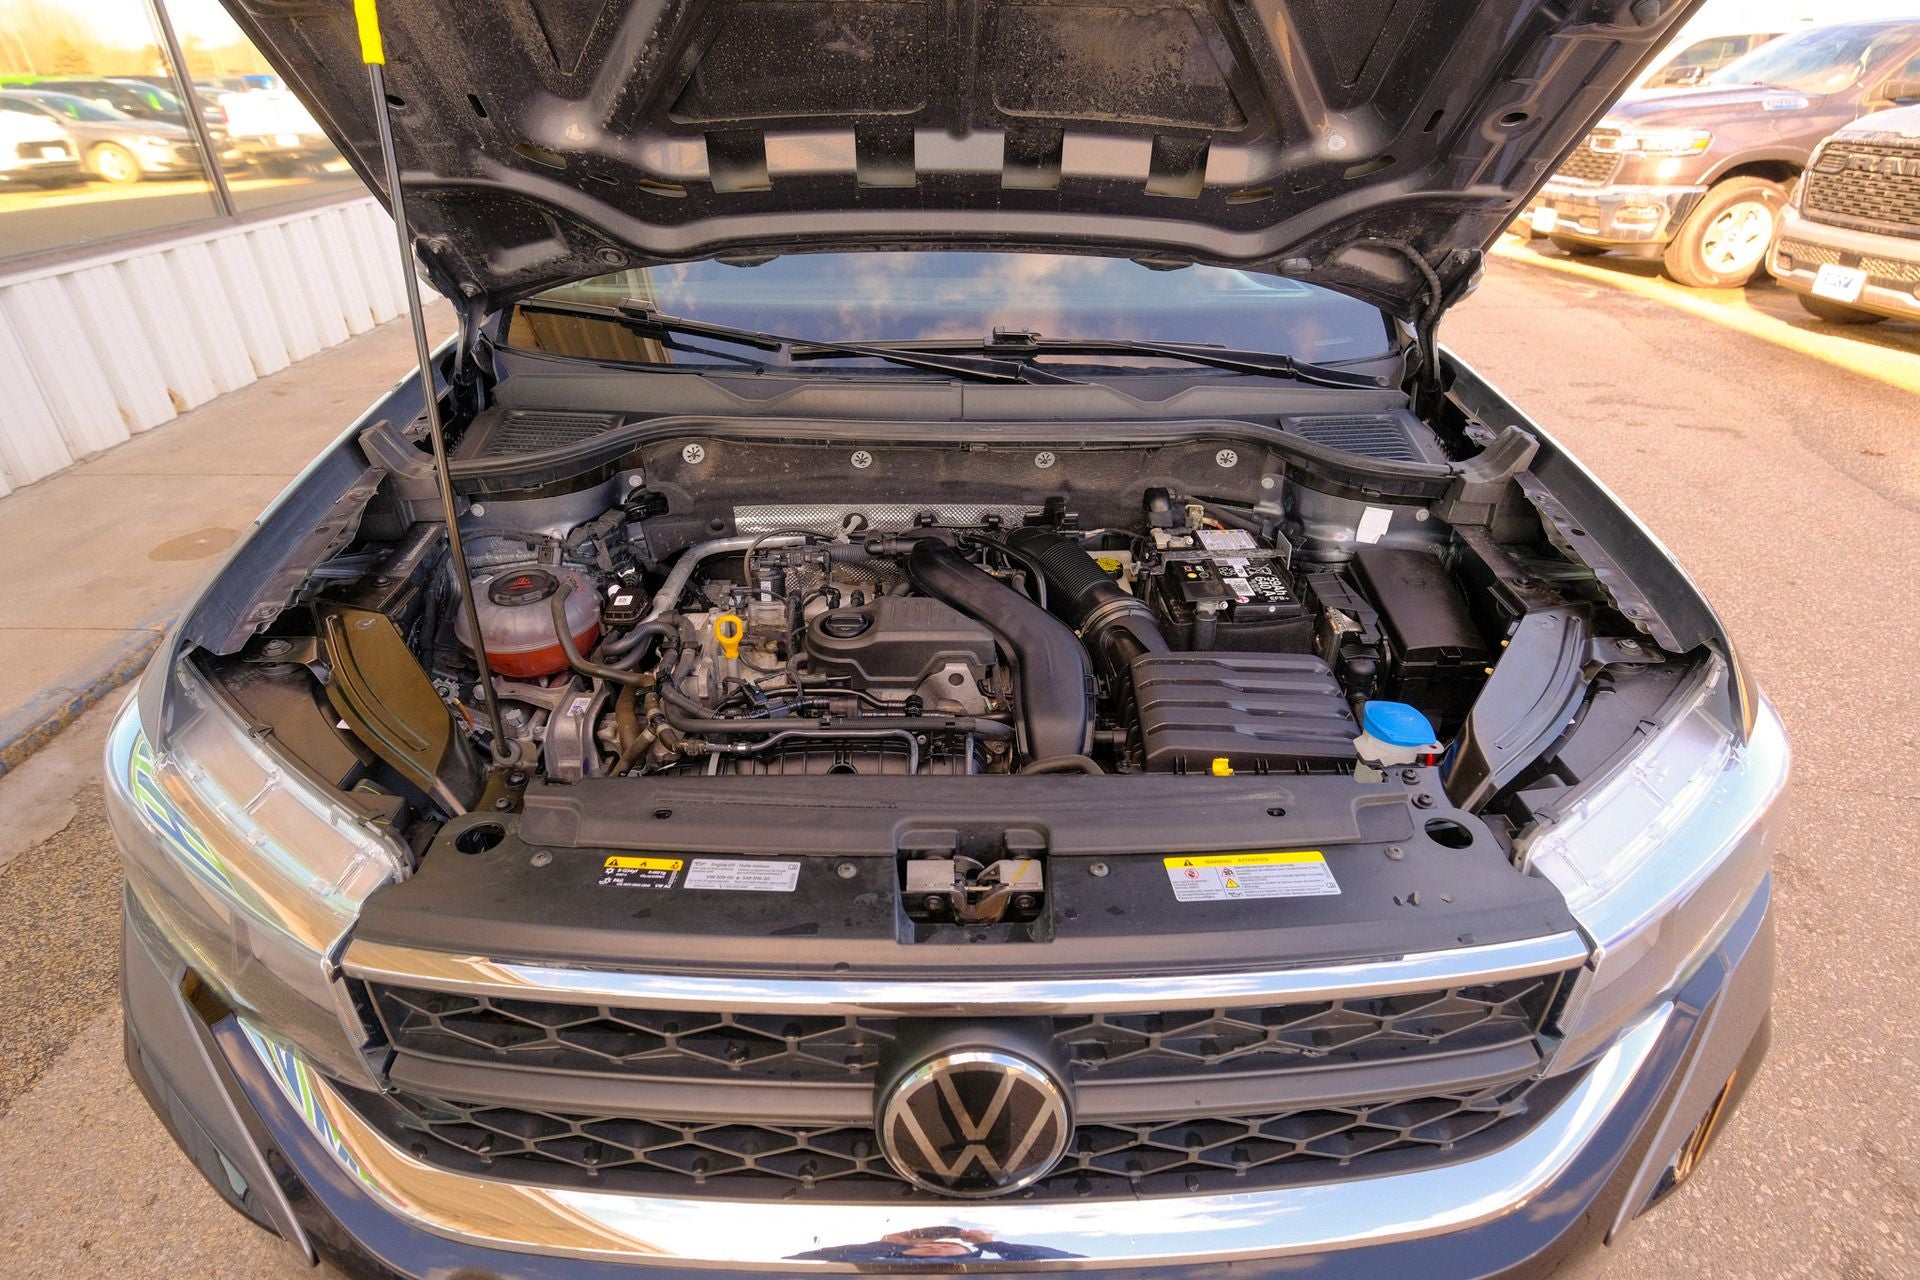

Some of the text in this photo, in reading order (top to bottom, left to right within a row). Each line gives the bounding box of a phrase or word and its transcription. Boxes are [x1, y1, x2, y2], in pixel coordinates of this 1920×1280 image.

[1255, 577, 1271, 589] 640
[1267, 577, 1287, 595] 59Ah
[890, 1060, 1060, 1190] VW
